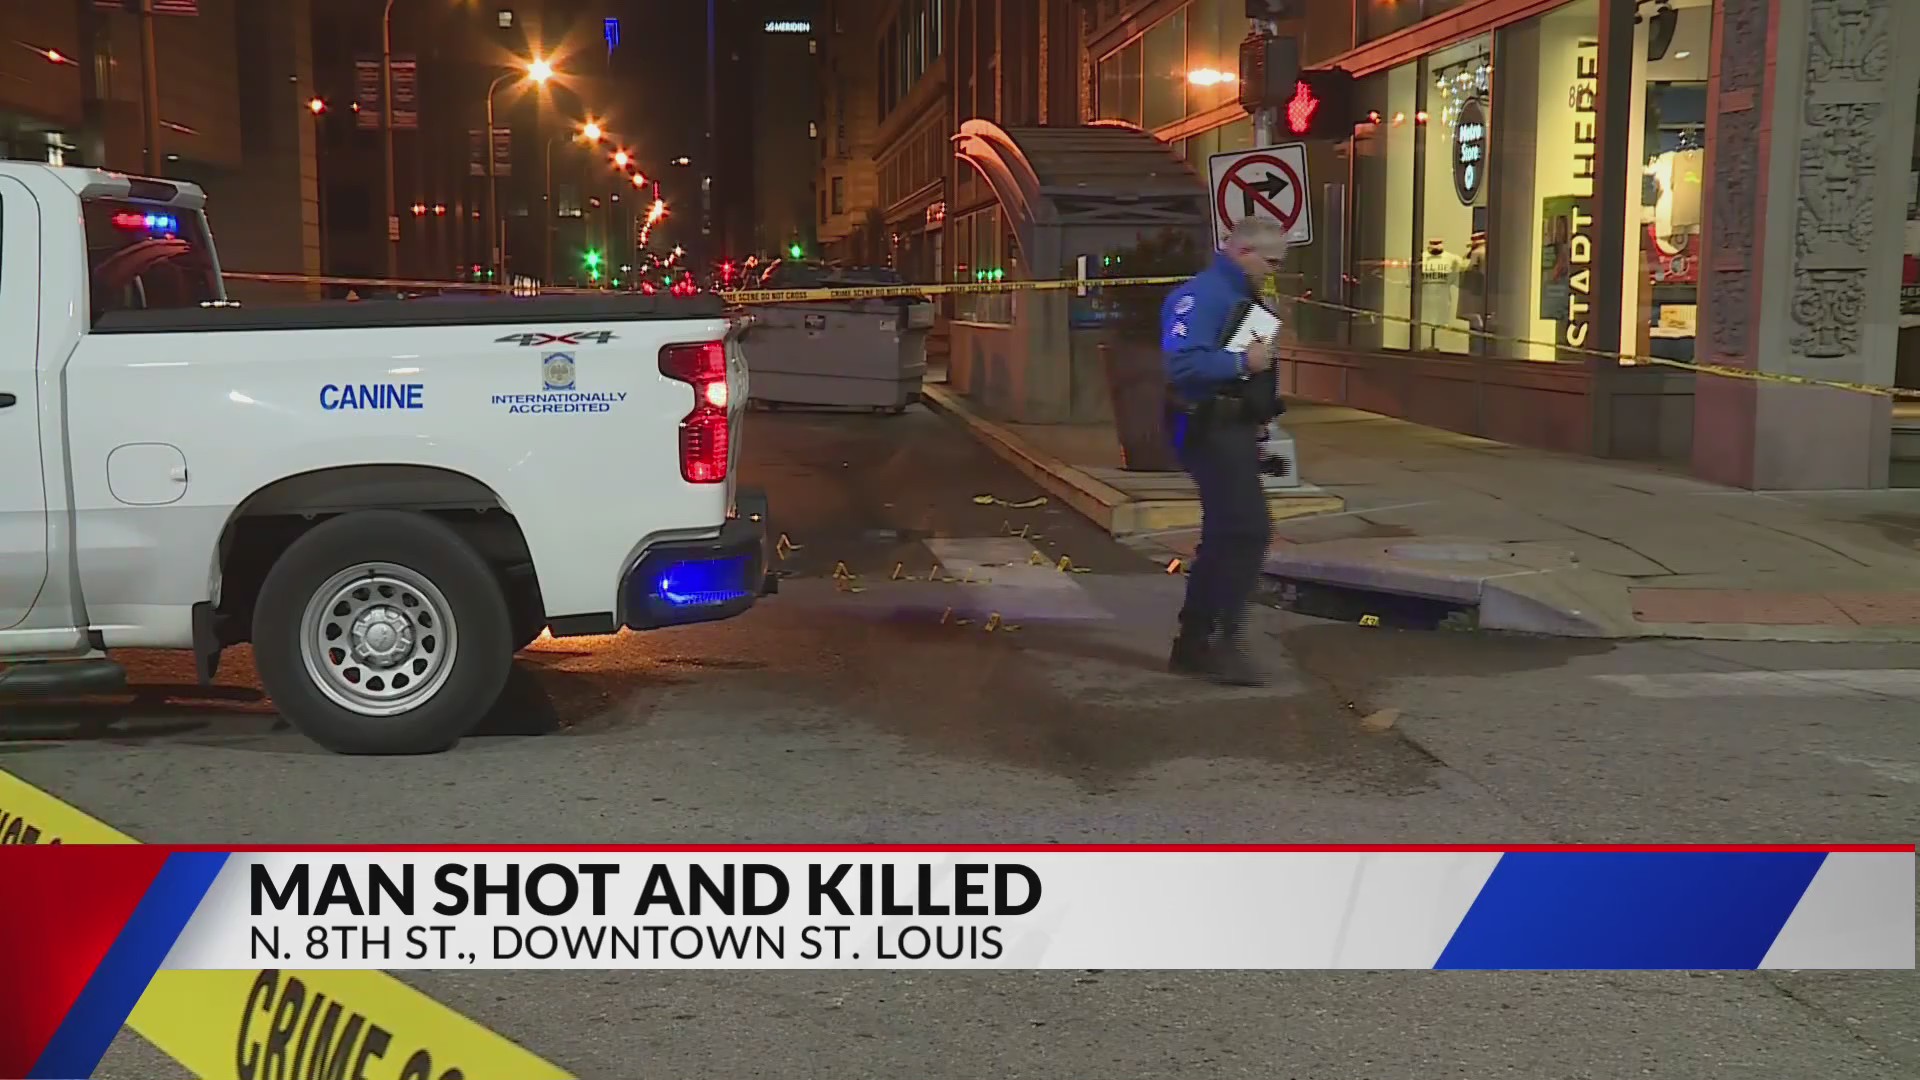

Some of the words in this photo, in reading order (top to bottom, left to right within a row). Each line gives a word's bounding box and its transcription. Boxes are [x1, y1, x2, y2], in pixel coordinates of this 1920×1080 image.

[320, 384, 424, 410] CANINE
[491, 392, 627, 404] INTERNATIONALLY
[508, 403, 610, 414] ACCREDITED
